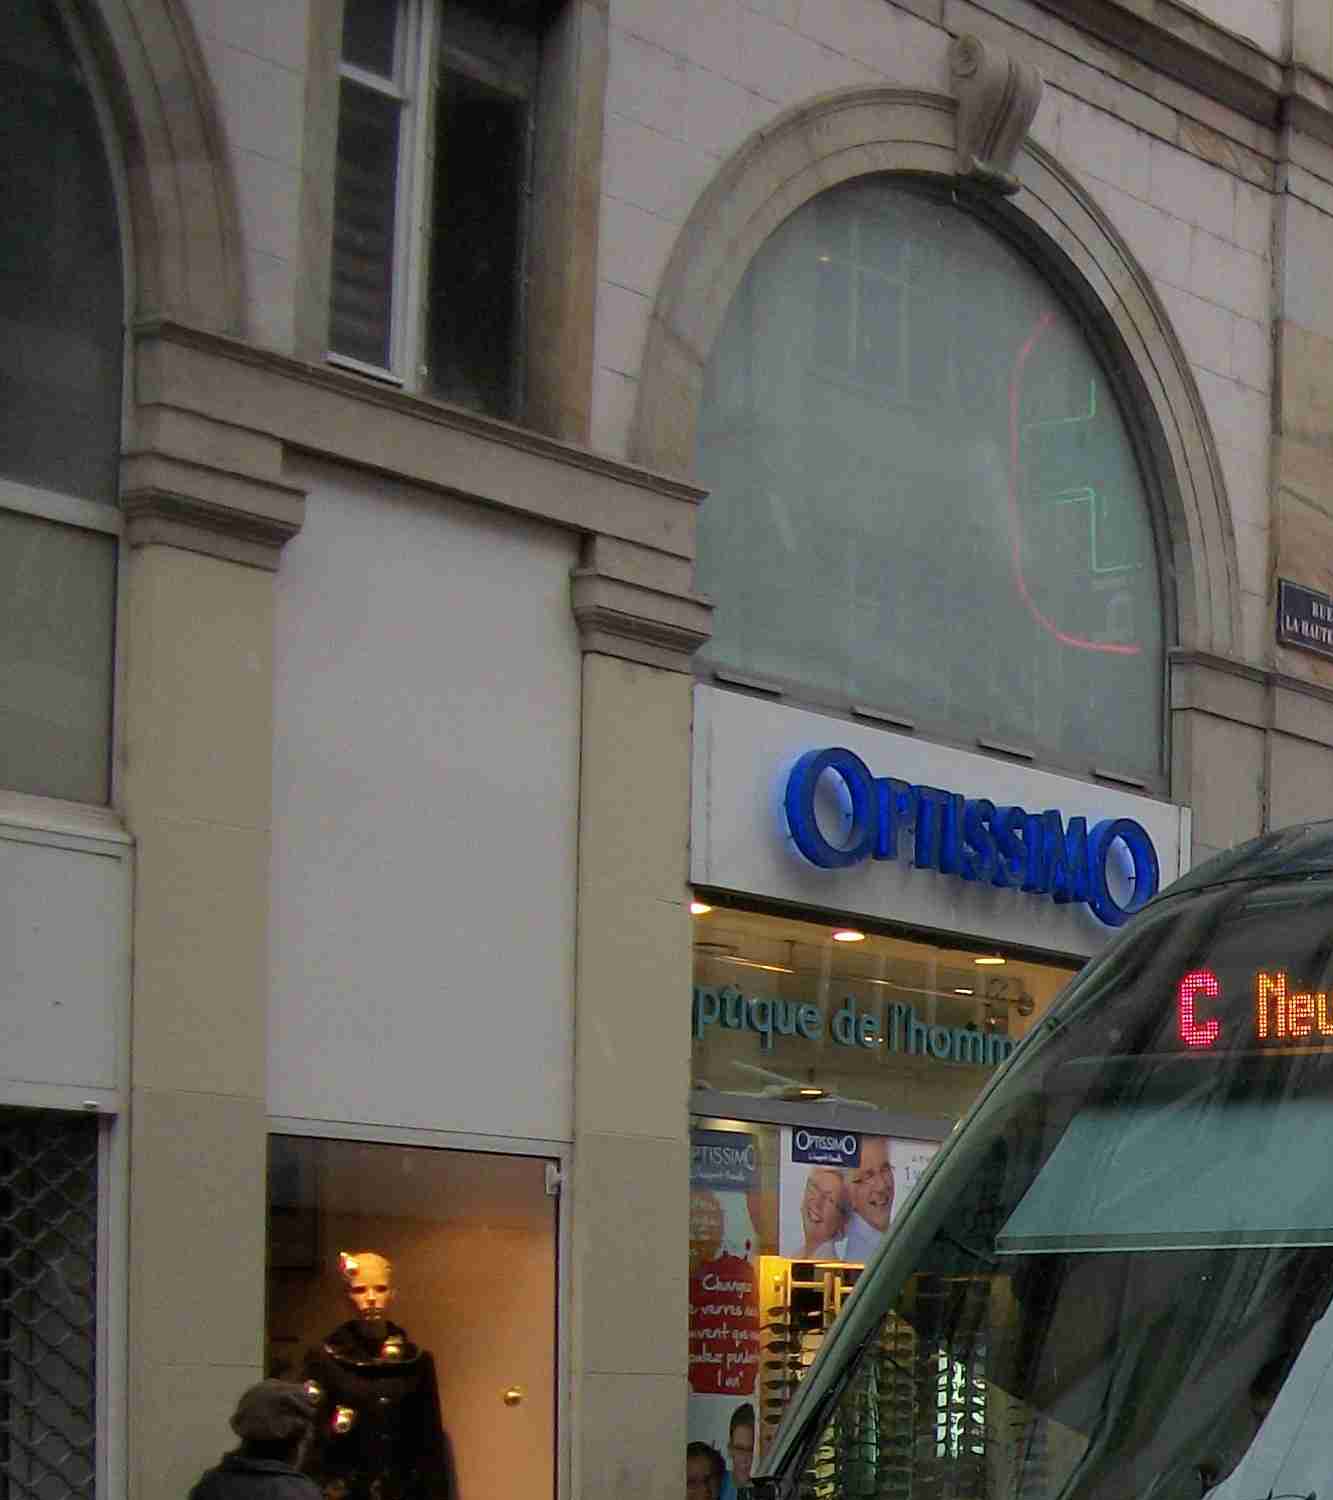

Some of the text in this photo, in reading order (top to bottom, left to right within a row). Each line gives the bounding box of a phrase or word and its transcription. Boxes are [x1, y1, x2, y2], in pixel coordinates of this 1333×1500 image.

[1286, 615, 1299, 632] LA
[785, 747, 1160, 926] OPTISSIMO
[692, 985, 1018, 1064] ptique de l'homm
[1177, 967, 1220, 1048] C
[797, 1130, 856, 1155] OPTISSIMO
